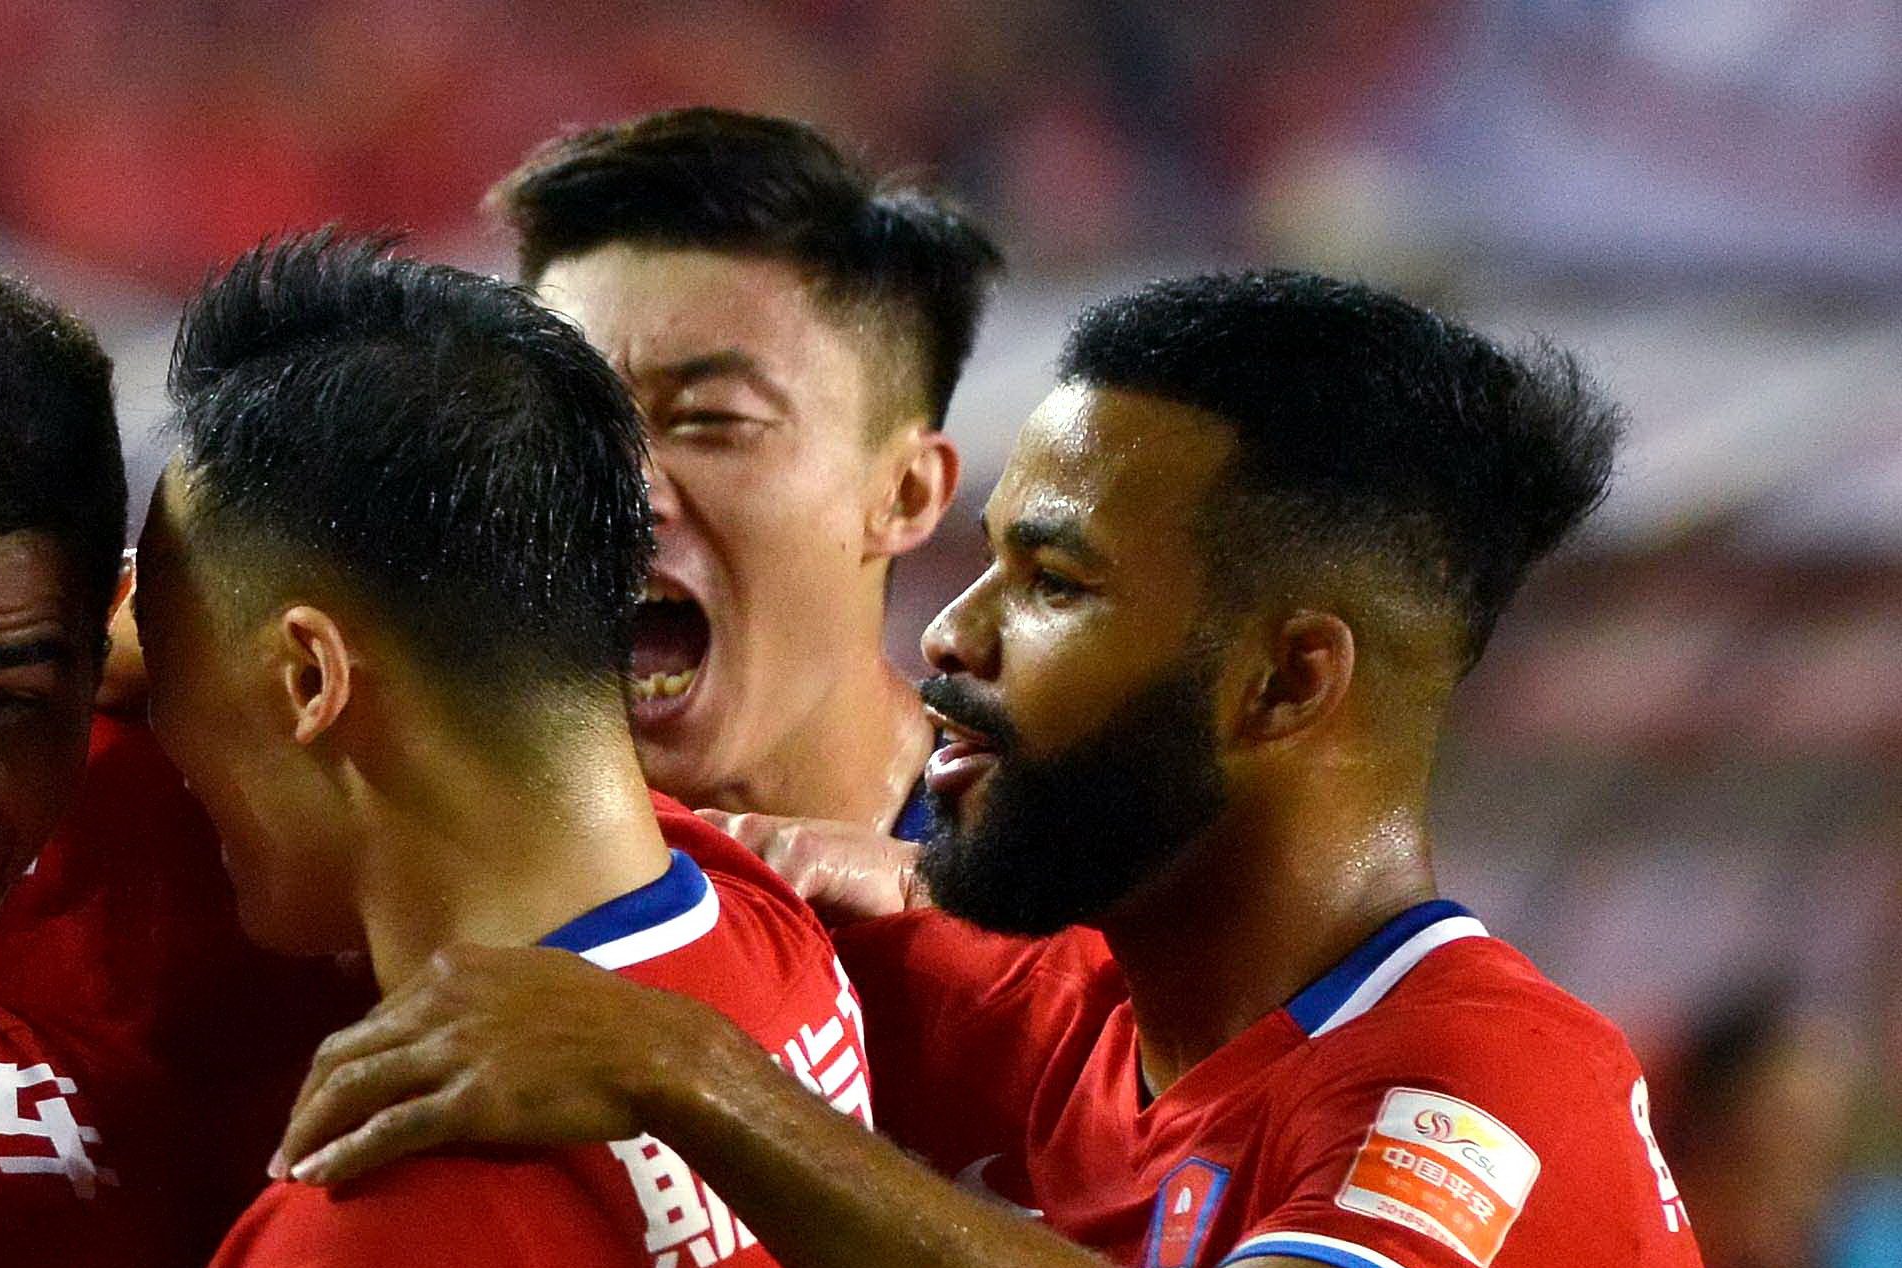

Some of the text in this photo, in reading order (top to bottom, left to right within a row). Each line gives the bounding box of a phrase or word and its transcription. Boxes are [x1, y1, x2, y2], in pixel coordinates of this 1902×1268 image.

[1382, 1145, 1496, 1226] 中国平安
[1462, 1146, 1498, 1179] CSL
